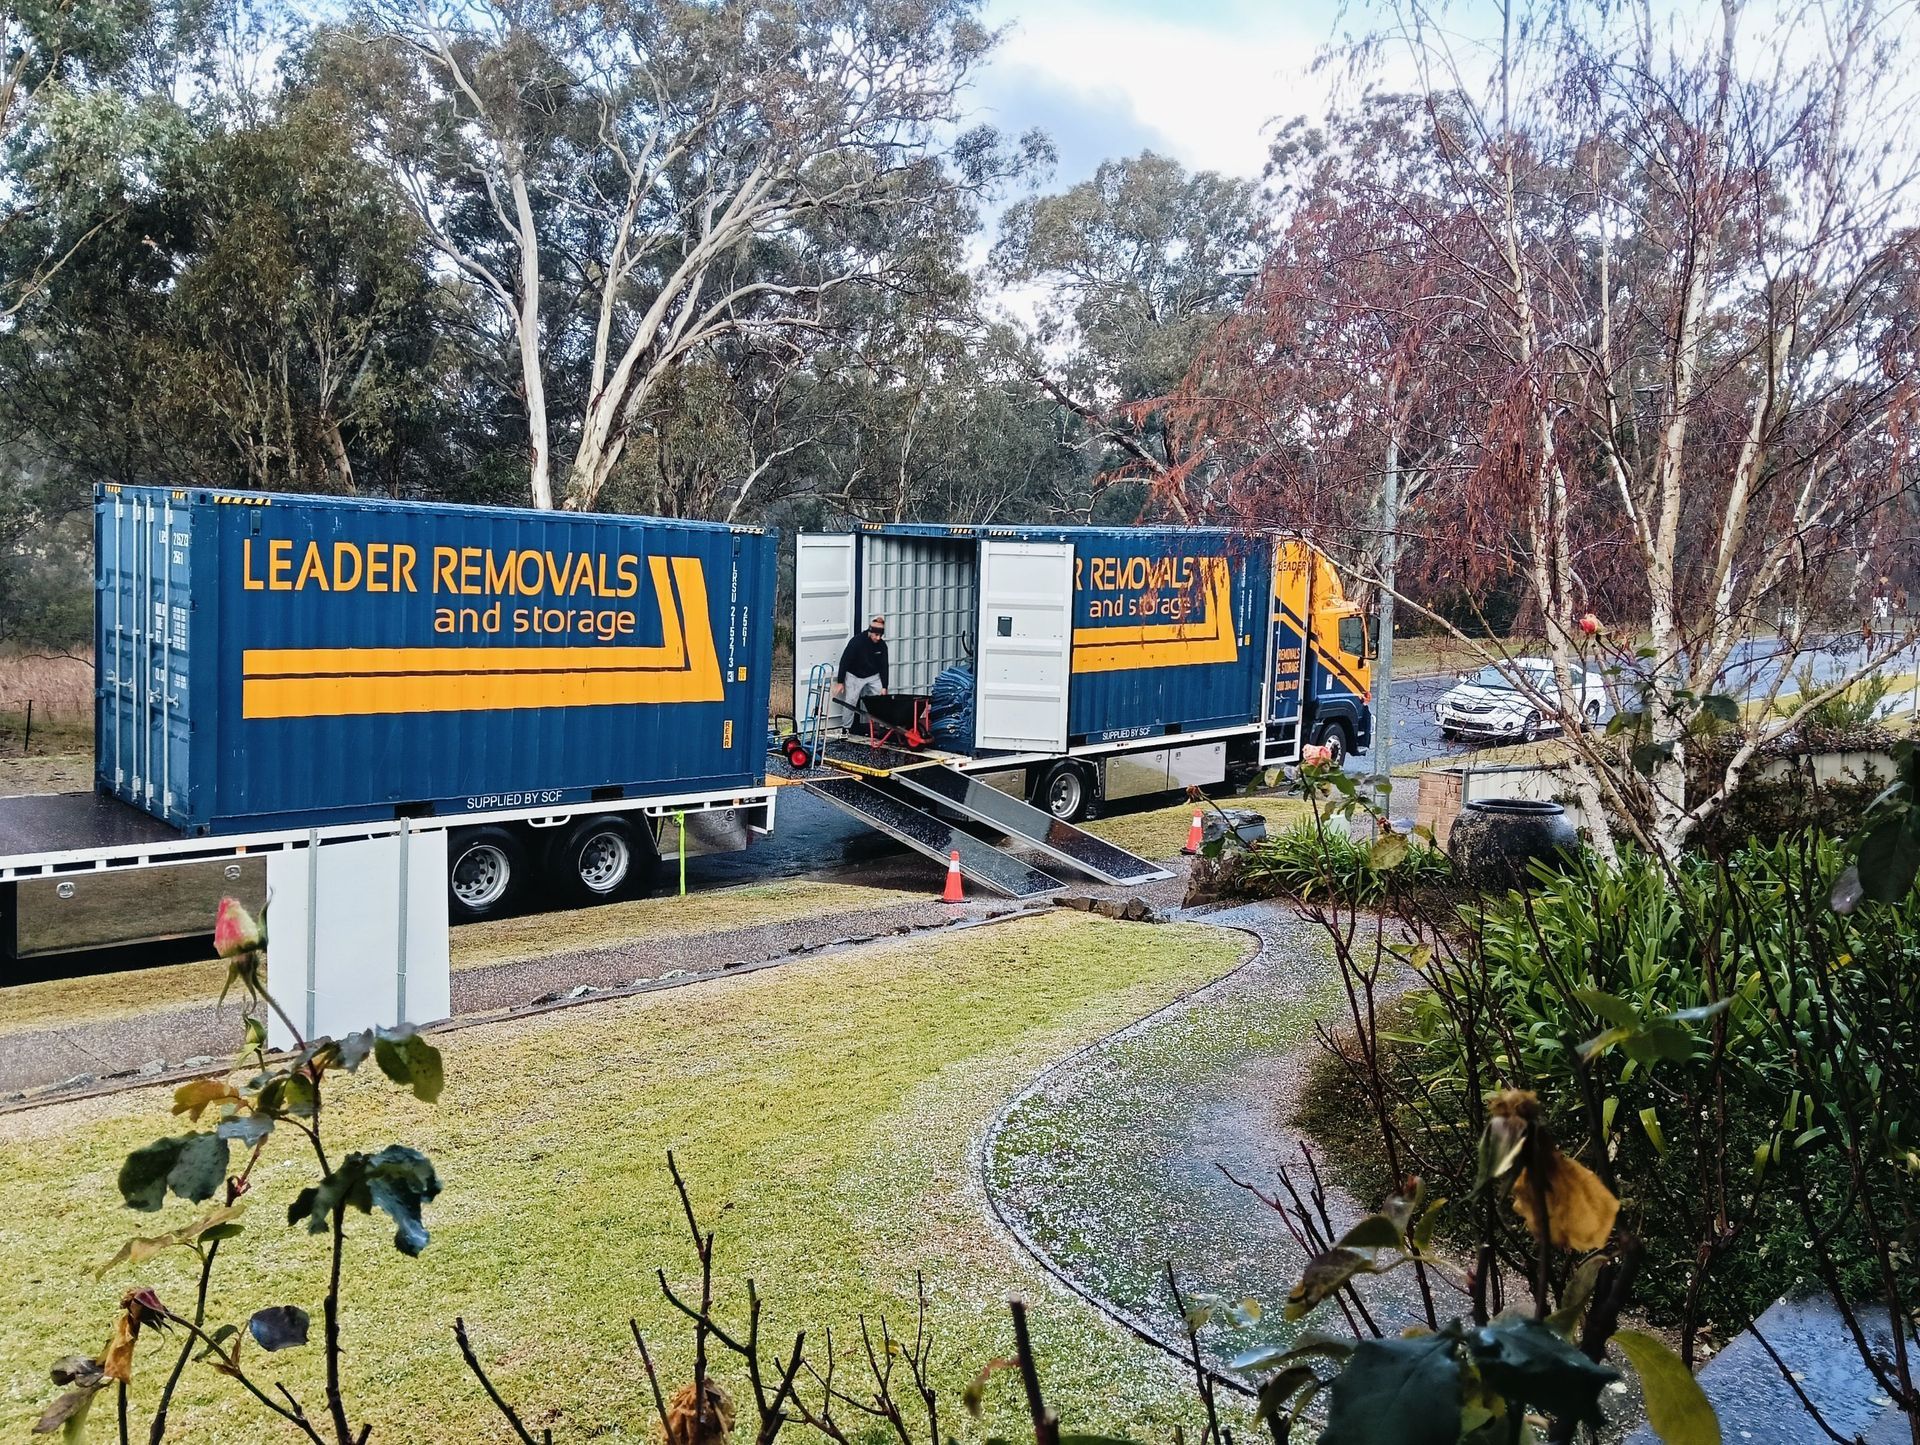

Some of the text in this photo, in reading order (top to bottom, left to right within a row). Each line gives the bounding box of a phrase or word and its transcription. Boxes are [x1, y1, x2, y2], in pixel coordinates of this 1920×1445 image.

[243, 538, 638, 598] LEADER REMOVALS
[1090, 557, 1194, 591] REMOVALS
[1278, 561, 1307, 572] LEADER
[1089, 594, 1123, 618] and
[434, 602, 635, 640] and storage
[728, 606, 736, 668] 215273
[1278, 648, 1300, 660] REMOVALS
[1281, 661, 1299, 674] STORAGE
[1102, 727, 1151, 740] SUPPLIED BY SCF
[467, 791, 563, 809] SUPPLIED BY SCF
